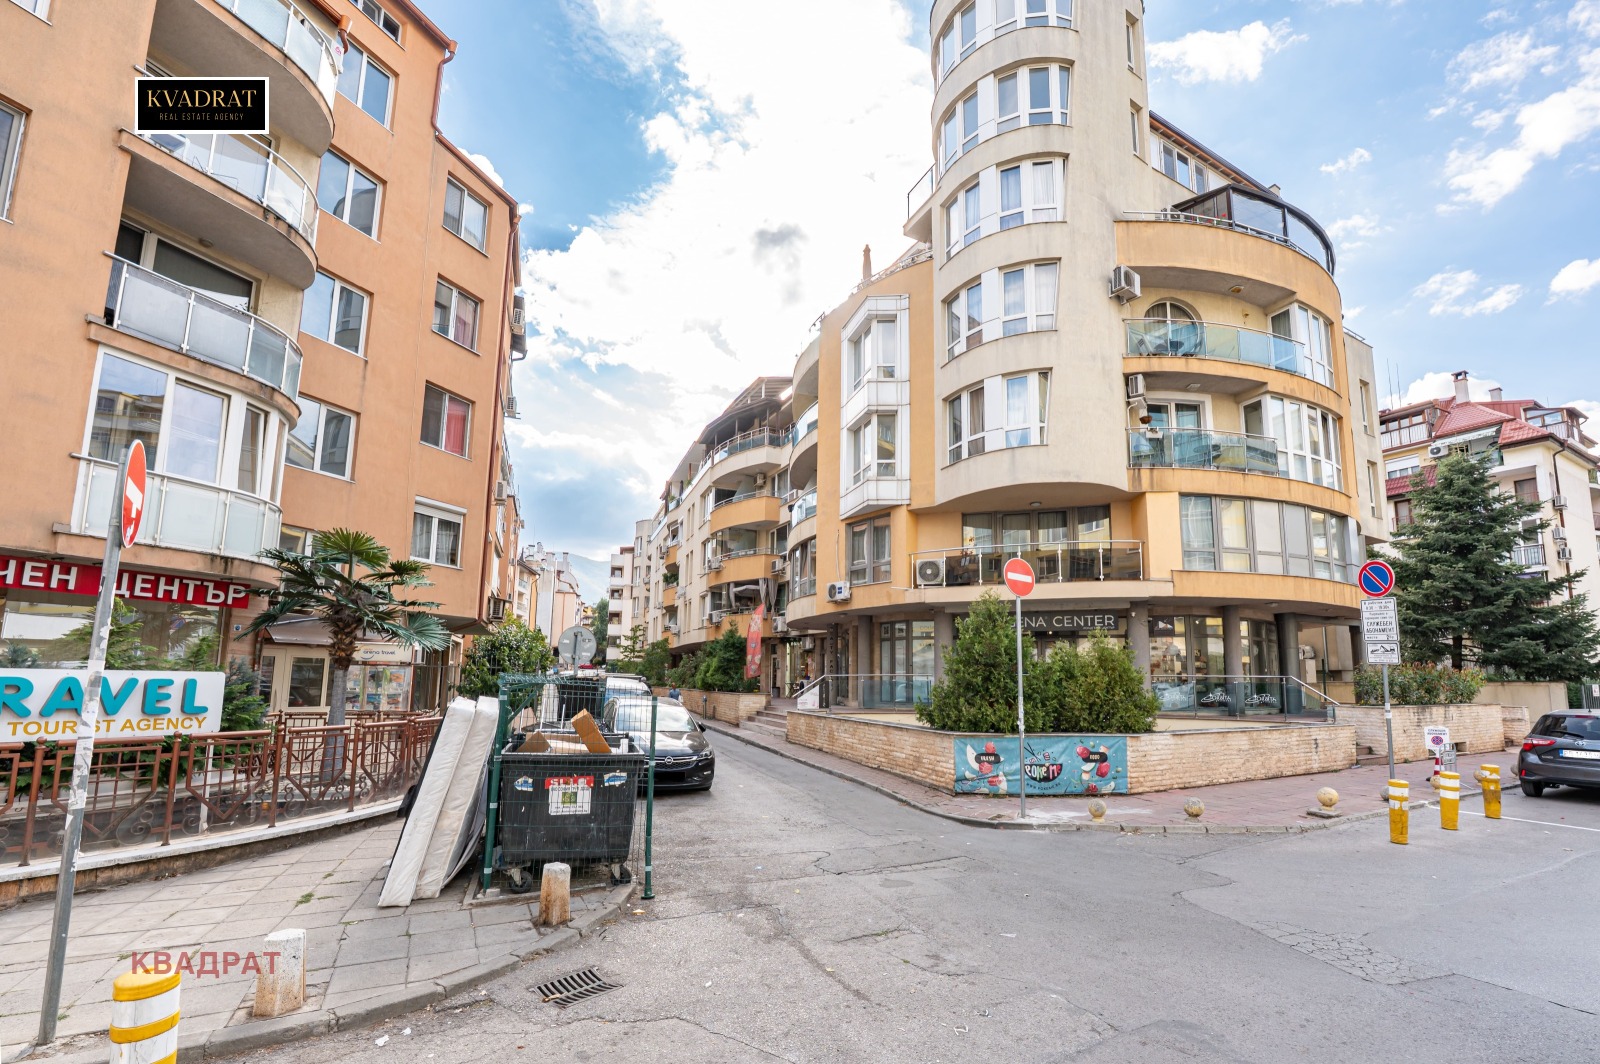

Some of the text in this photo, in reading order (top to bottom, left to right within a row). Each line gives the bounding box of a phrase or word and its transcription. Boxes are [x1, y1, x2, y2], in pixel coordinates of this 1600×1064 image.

[1052, 614, 1115, 627] CENTER
[0, 676, 209, 718] RAVEL
[7, 716, 208, 736] TOURST AGENCY
